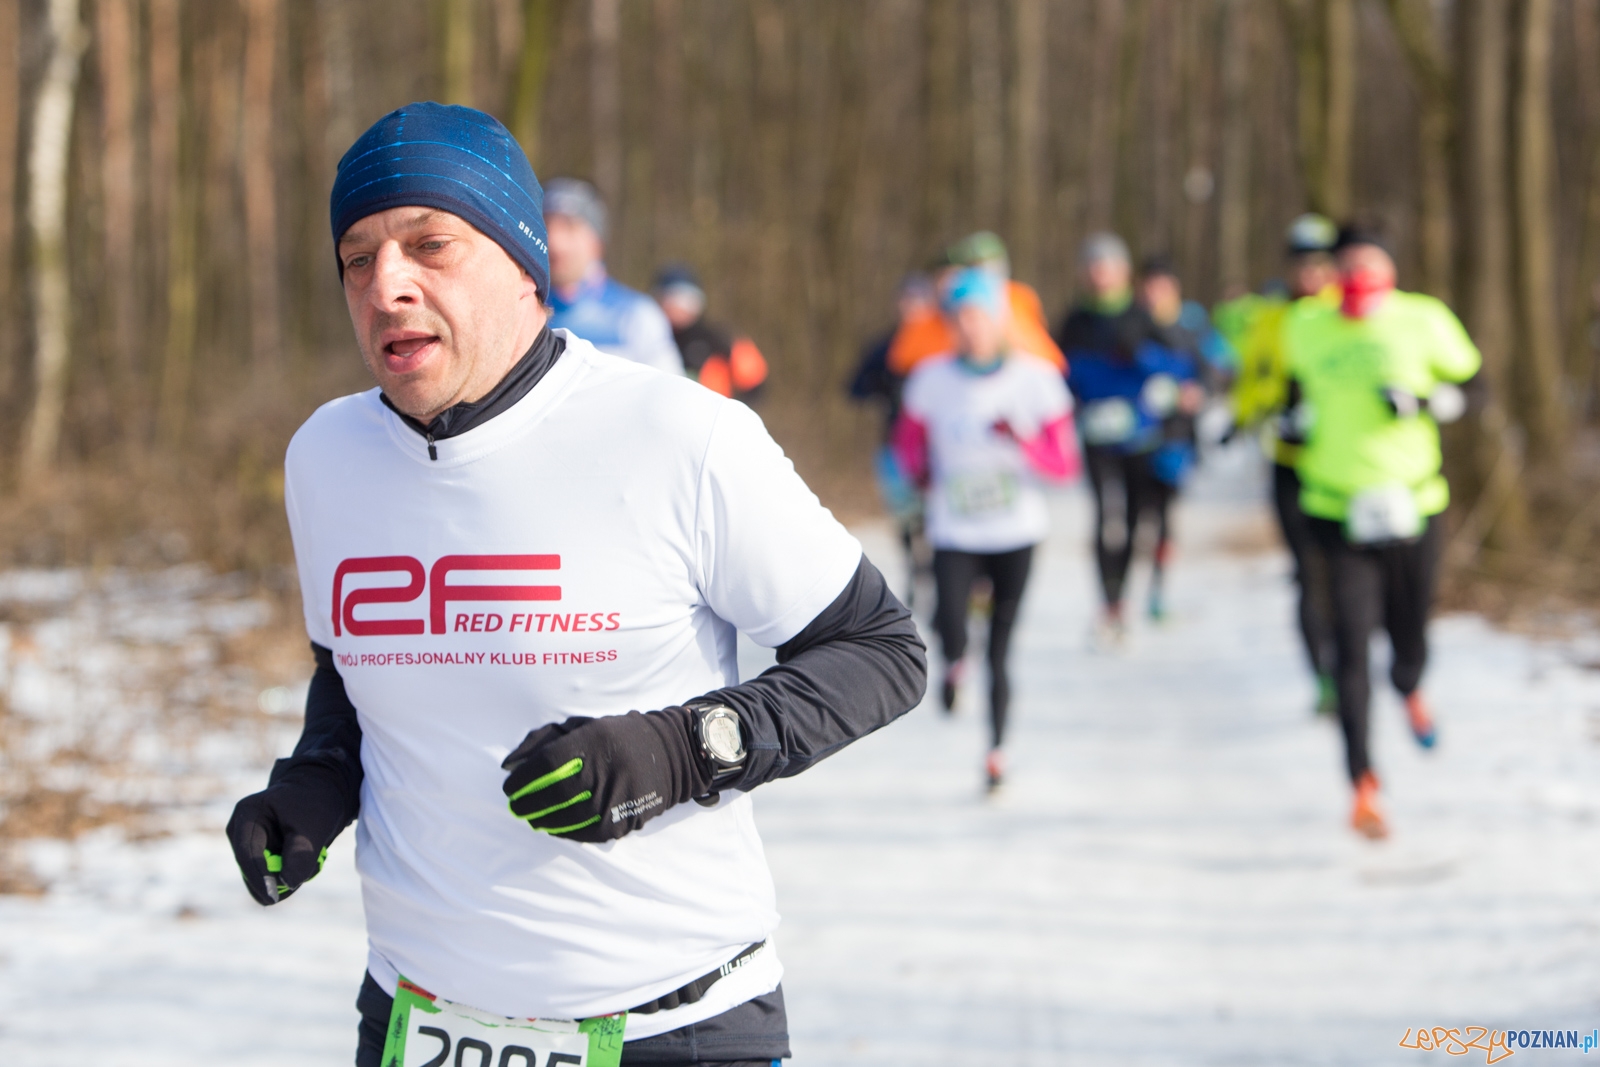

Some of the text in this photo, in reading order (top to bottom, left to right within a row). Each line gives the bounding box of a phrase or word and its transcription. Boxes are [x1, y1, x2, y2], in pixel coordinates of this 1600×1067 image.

[518, 220, 548, 254] DRI-FIT
[454, 612, 620, 632] RED FITNESS
[337, 649, 618, 666] TWÓJ PROFESJONALNY KLUB FITNESS
[417, 1026, 582, 1067] 20
